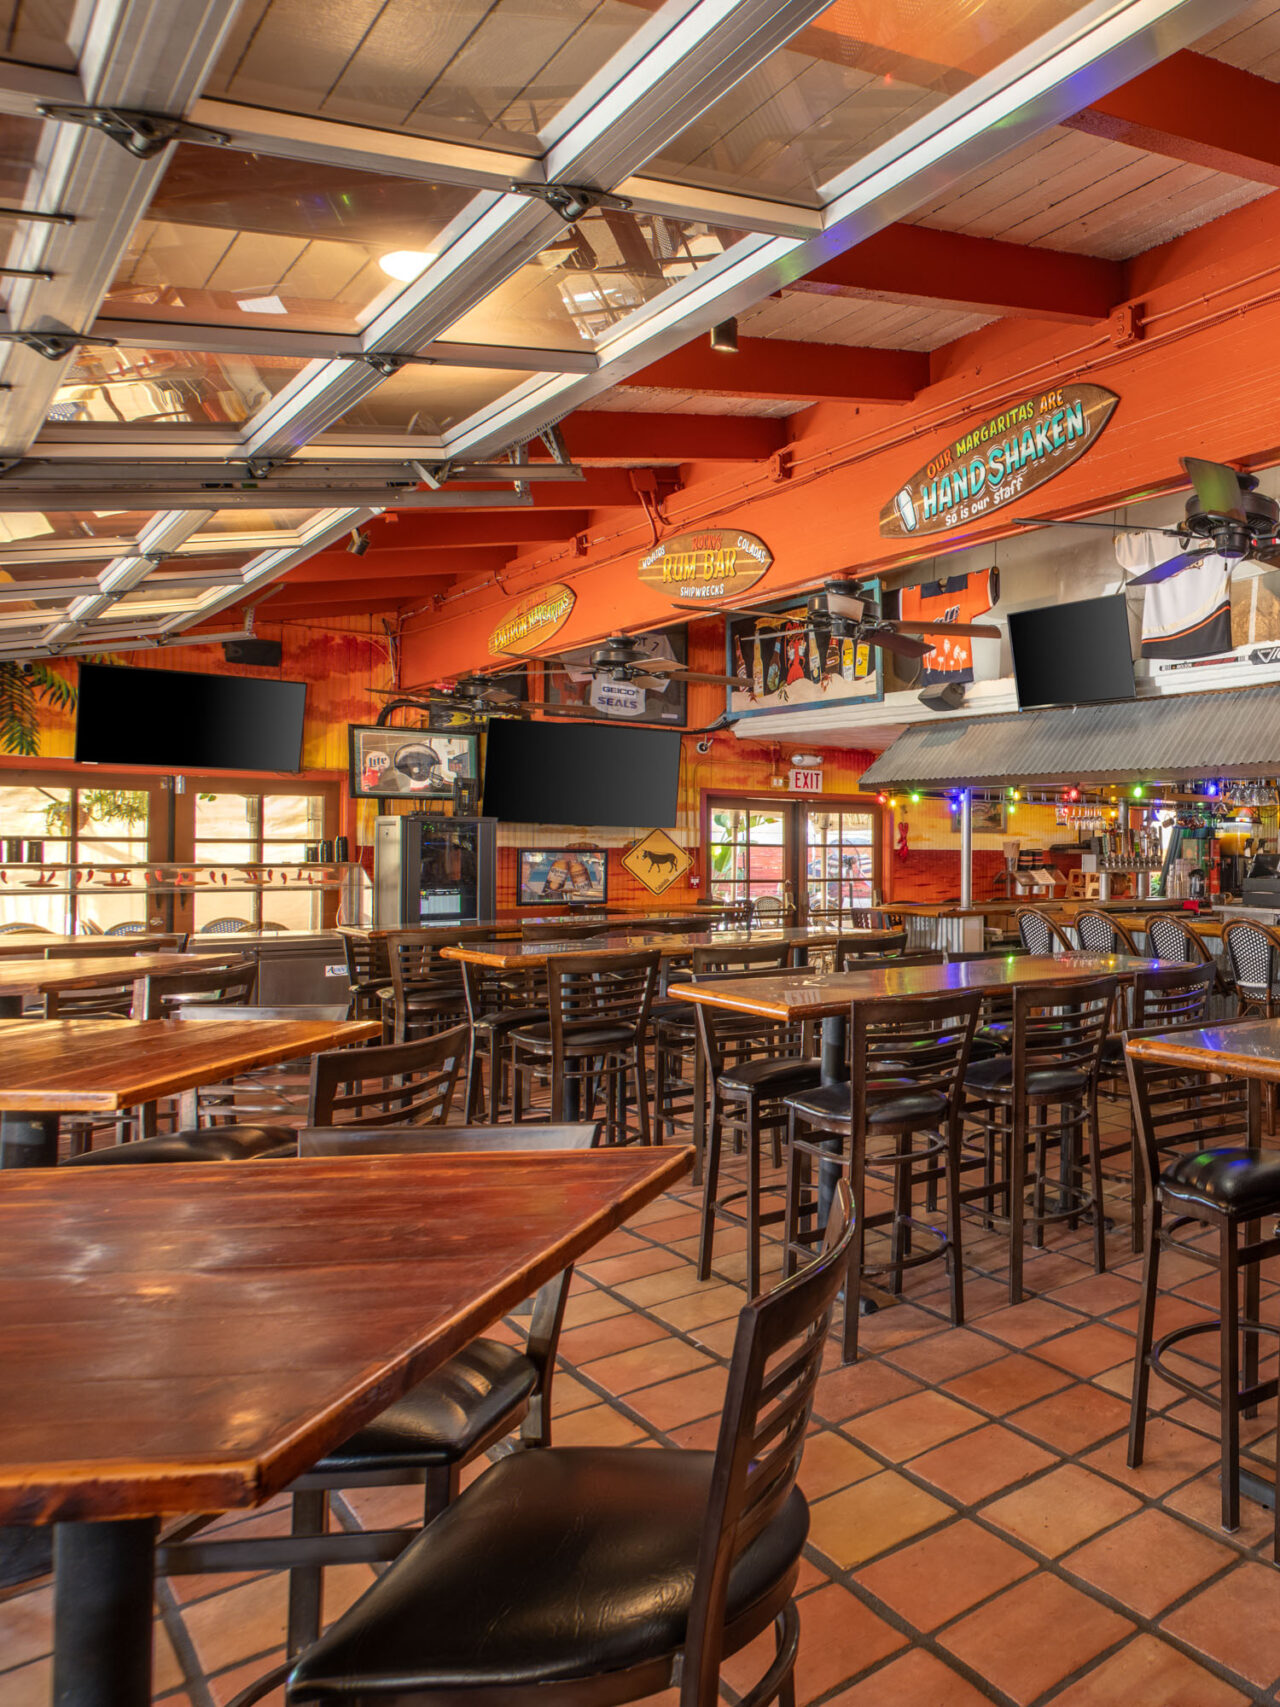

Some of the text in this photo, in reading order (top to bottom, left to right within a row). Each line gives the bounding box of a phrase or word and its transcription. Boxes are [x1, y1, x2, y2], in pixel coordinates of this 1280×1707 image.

[927, 389, 1064, 479] OUR MARGARITAS ARE
[922, 402, 1085, 519] HANDSHAKEN
[960, 505, 969, 519] is
[971, 497, 990, 514] our
[737, 536, 766, 564] COLADAS
[663, 547, 737, 583] RUM BAR
[680, 584, 724, 597] SHIPWRECKS
[602, 686, 636, 696] GEICO
[598, 696, 638, 710] SEALS
[795, 771, 821, 789] EXIT
